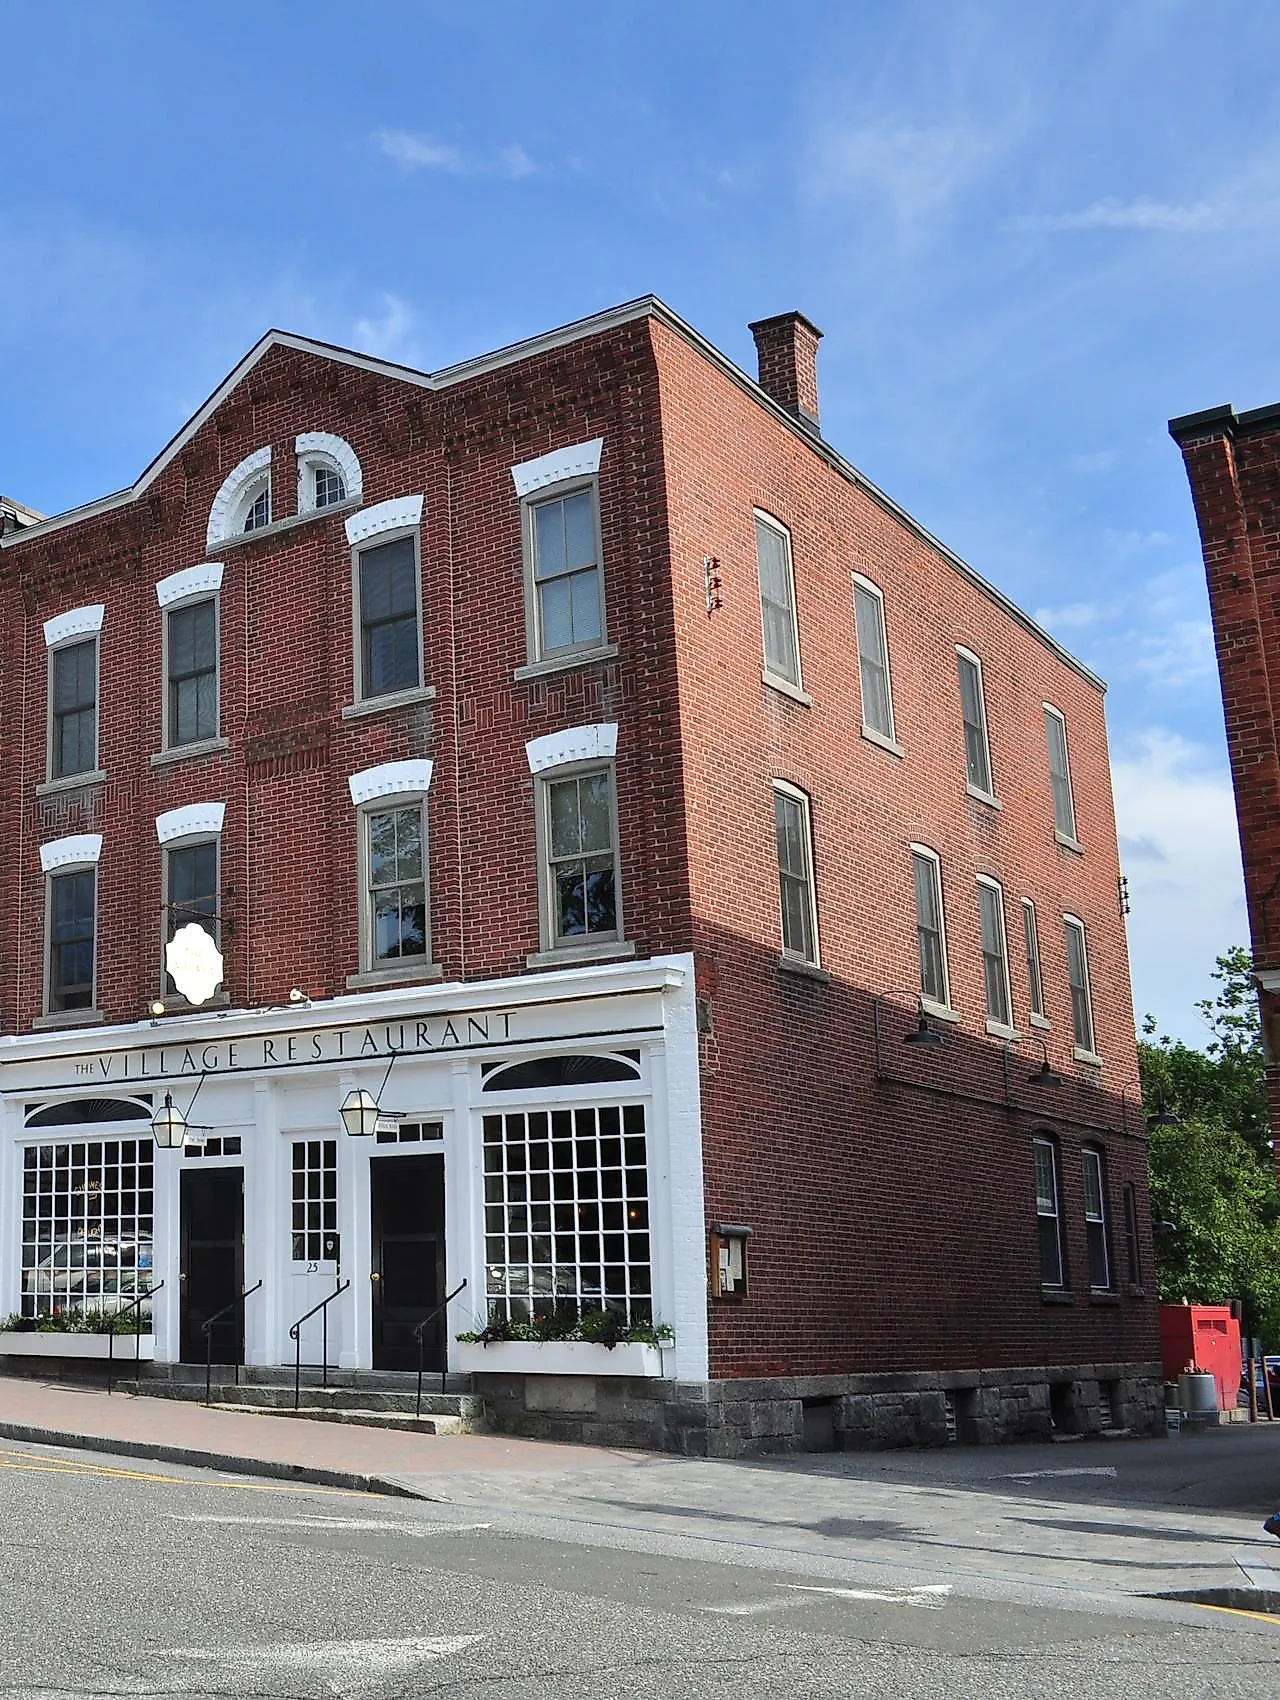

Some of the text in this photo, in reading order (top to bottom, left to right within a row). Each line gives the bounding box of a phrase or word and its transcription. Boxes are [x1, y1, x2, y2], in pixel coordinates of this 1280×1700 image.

[74, 1012, 518, 1078] THE VILLAGE RESTAURANT
[306, 1262, 319, 1273] 25
